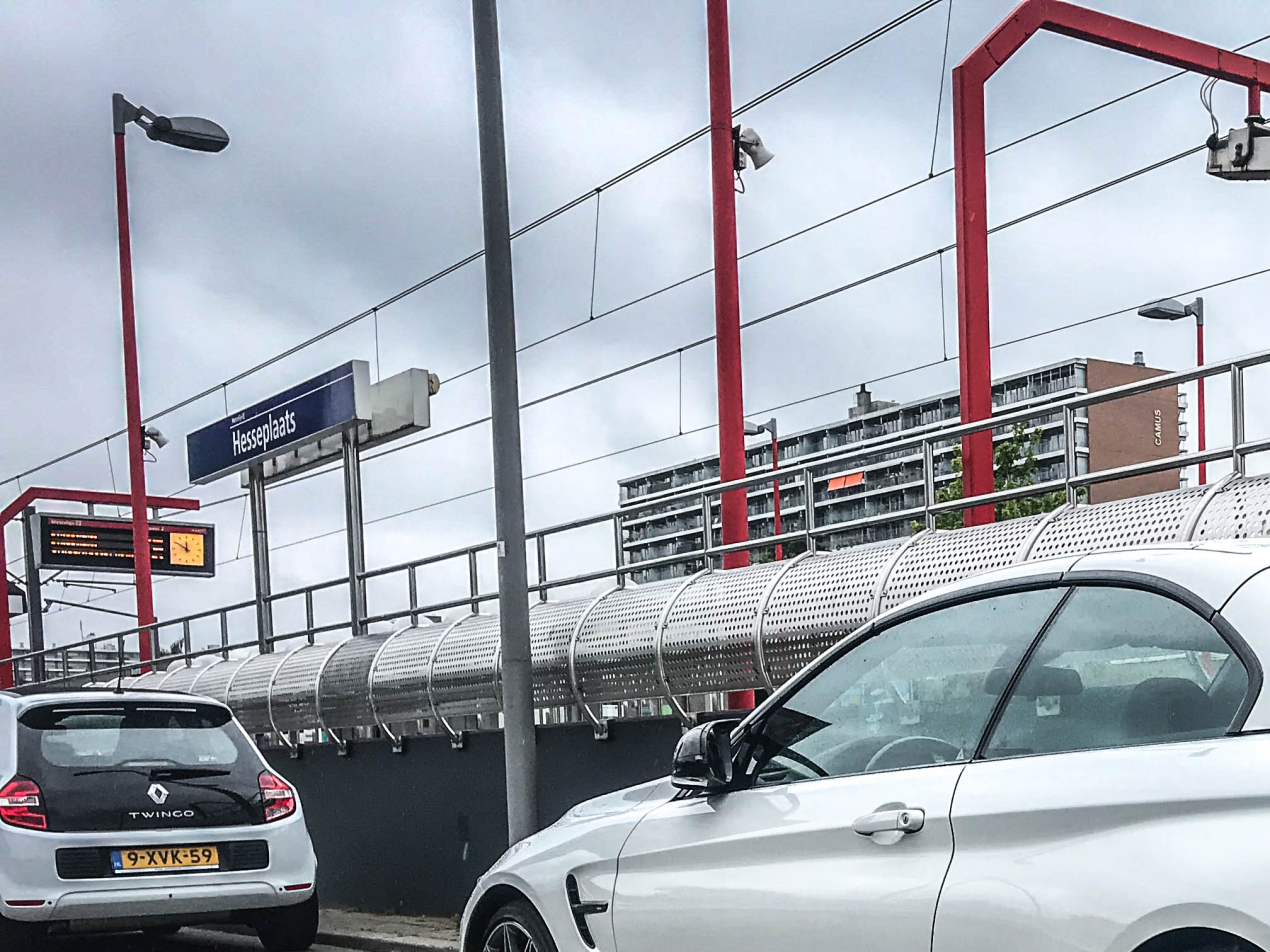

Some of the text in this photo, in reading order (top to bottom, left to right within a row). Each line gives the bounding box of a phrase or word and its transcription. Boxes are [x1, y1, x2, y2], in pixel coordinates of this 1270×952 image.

[232, 409, 296, 456] Hesseplaats
[1154, 409, 1162, 446] CAMUS
[128, 810, 195, 819] TWINGO
[127, 848, 212, 867] 9-XVK-59
